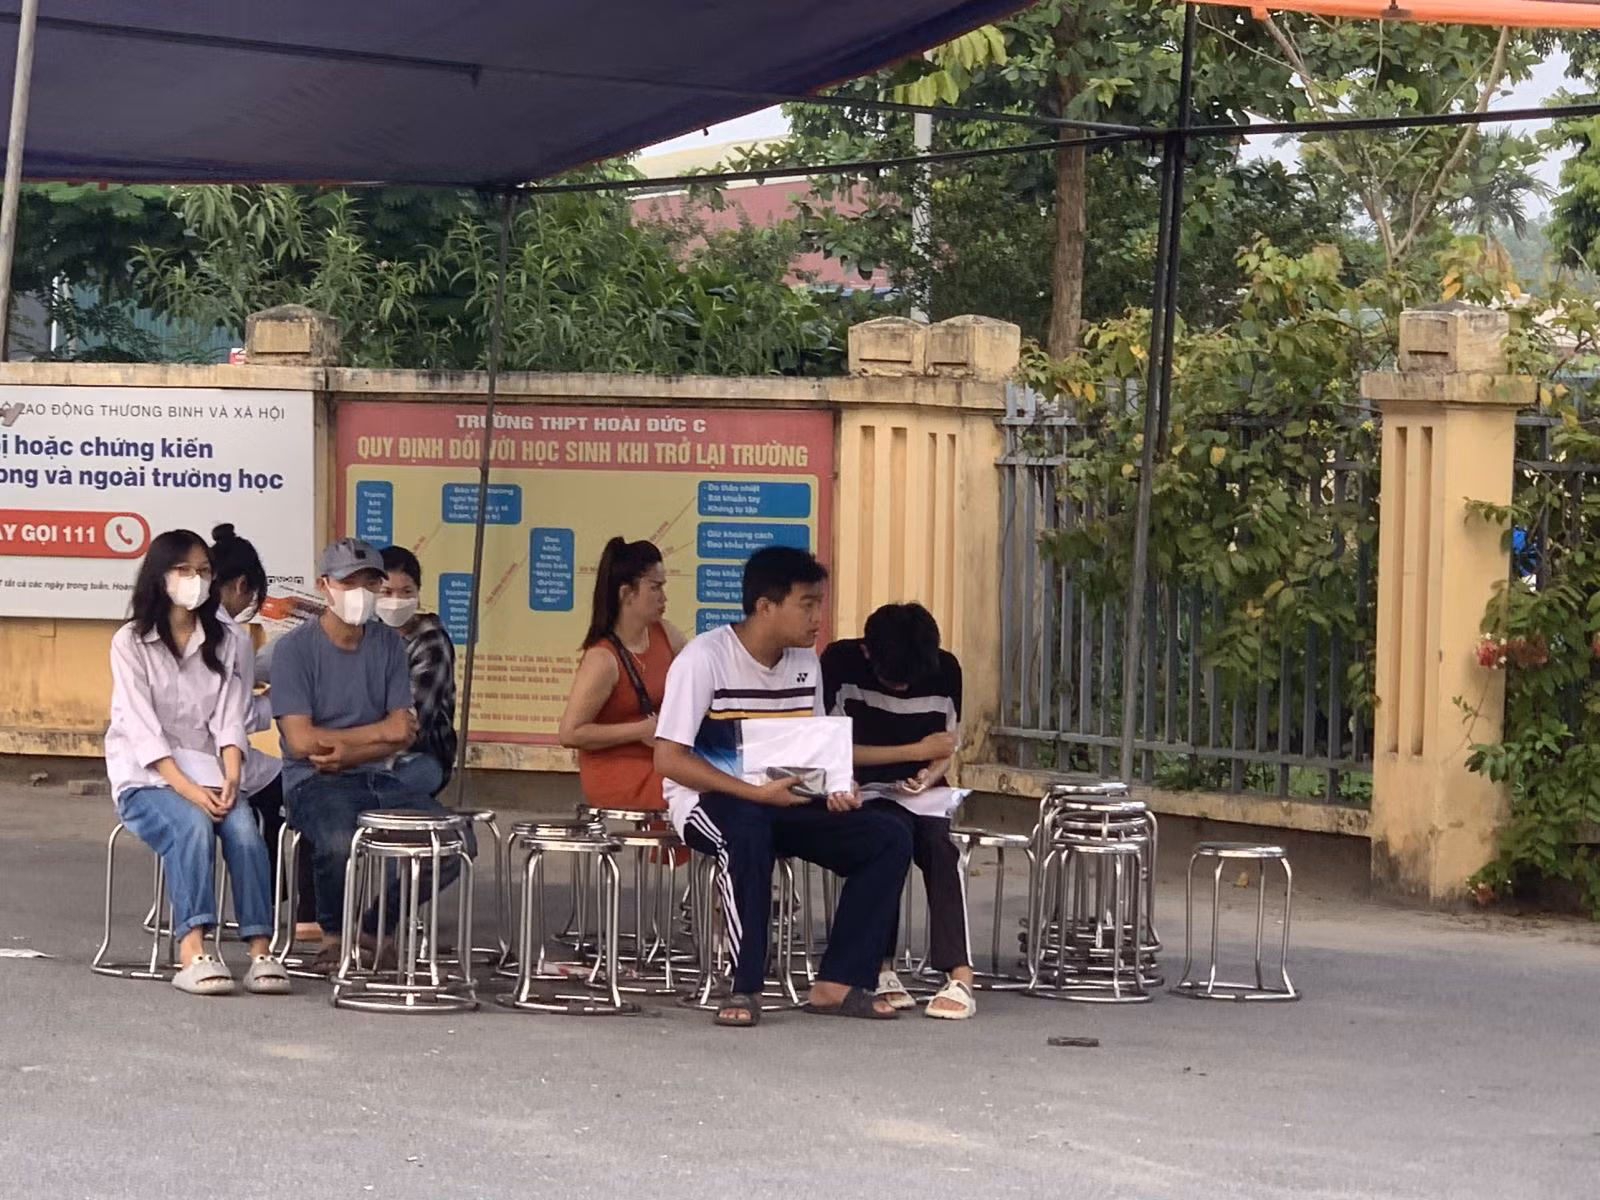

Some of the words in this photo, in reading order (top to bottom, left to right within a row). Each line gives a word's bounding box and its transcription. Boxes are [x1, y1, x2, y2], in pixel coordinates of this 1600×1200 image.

[19, 404, 46, 415] AO
[51, 402, 94, 418] ĐỘNG
[100, 403, 162, 418] THƯƠNG
[168, 405, 203, 418] BINH
[209, 404, 228, 418] VÀ
[259, 405, 285, 421] HỘI
[540, 415, 588, 431] THPT
[594, 415, 640, 432] HOÀI
[647, 414, 687, 432] ĐỨC
[693, 418, 706, 433] C
[15, 434, 74, 460] hoặc
[80, 437, 154, 461] chứng
[161, 437, 213, 459] kiến
[358, 436, 394, 459] QUY
[399, 437, 443, 463] ĐỊNH
[450, 431, 481, 460] ĐỐI
[522, 440, 559, 466] HỌC
[565, 441, 611, 463] SINH
[617, 442, 648, 464] KHI
[655, 436, 690, 464] TRỞ
[696, 443, 726, 470] LẠI
[732, 440, 809, 467] TRƯỜNG
[0, 468, 38, 488] ong
[45, 465, 73, 485] và
[79, 466, 145, 490] ngoài
[152, 466, 232, 492] trường
[238, 468, 284, 493] học
[22, 524, 57, 545] GỌI
[62, 525, 95, 543] 111
